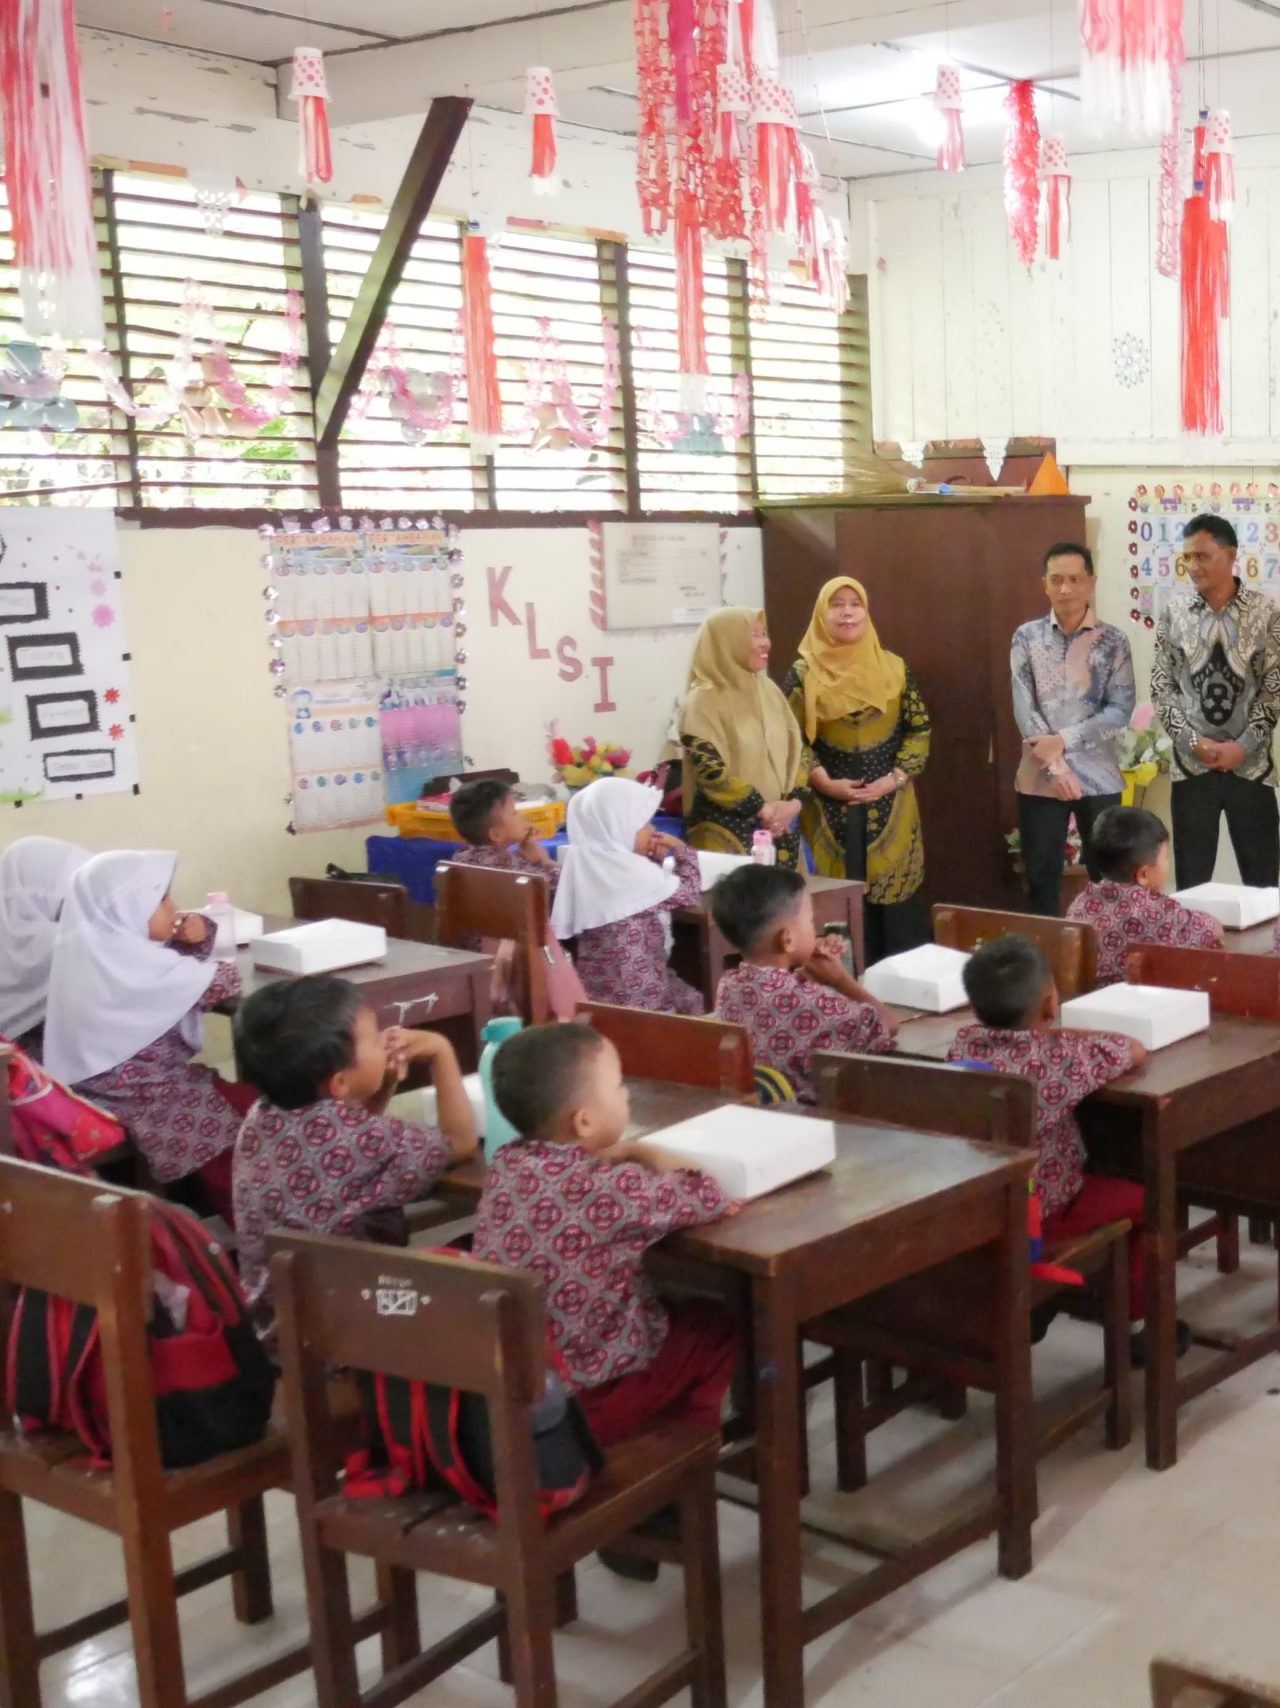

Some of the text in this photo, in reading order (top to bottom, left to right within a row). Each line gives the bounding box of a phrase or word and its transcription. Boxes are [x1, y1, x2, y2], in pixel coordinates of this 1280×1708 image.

[1141, 521, 1153, 542] 0
[1158, 522, 1169, 543] 1
[1246, 521, 1279, 544] 2 3
[1141, 556, 1153, 577] 4
[1158, 556, 1171, 577] 5
[1246, 556, 1259, 578] 6
[1266, 558, 1280, 580] 7
